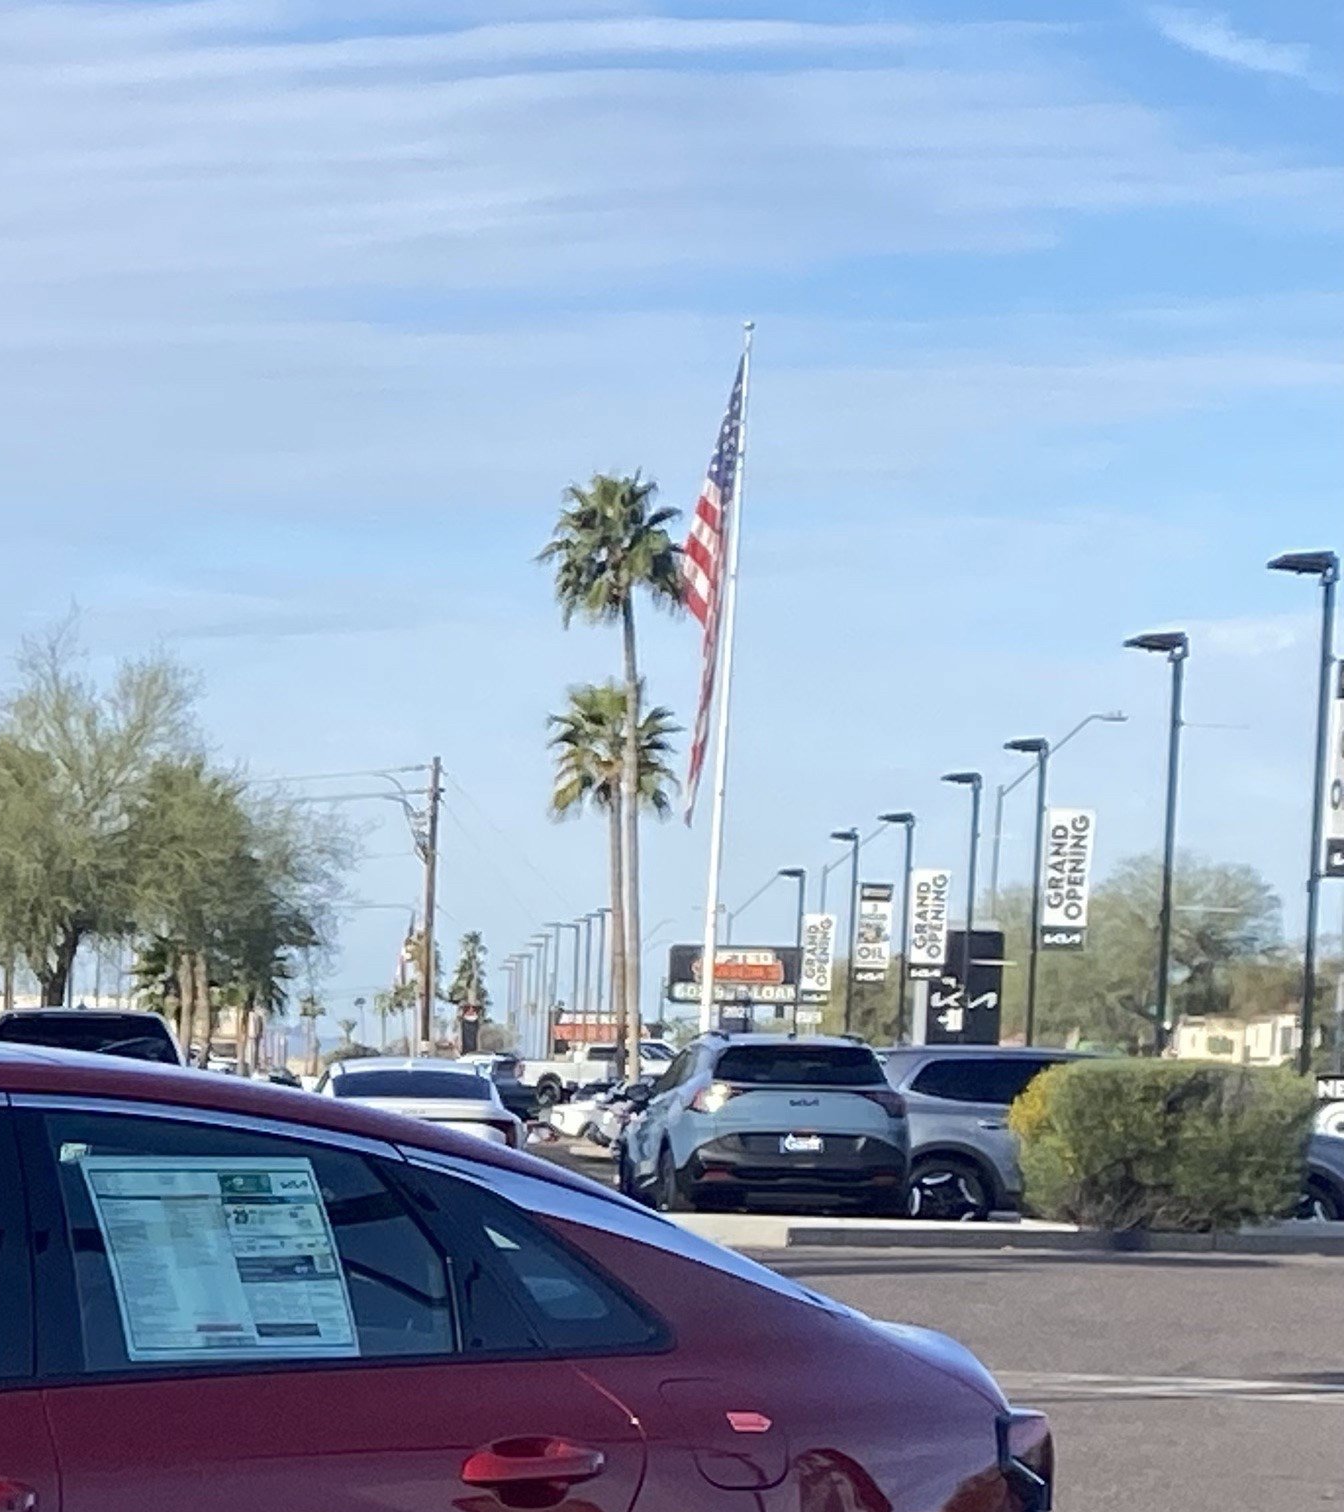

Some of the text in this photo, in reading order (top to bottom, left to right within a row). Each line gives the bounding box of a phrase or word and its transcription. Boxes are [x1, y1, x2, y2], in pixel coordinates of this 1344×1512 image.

[1047, 824, 1069, 909] GRAND
[1064, 814, 1091, 921] OPENING
[805, 924, 820, 979] GRAND
[858, 946, 886, 960] OIL
[913, 881, 931, 950] GRAND
[927, 873, 949, 959] OPENING
